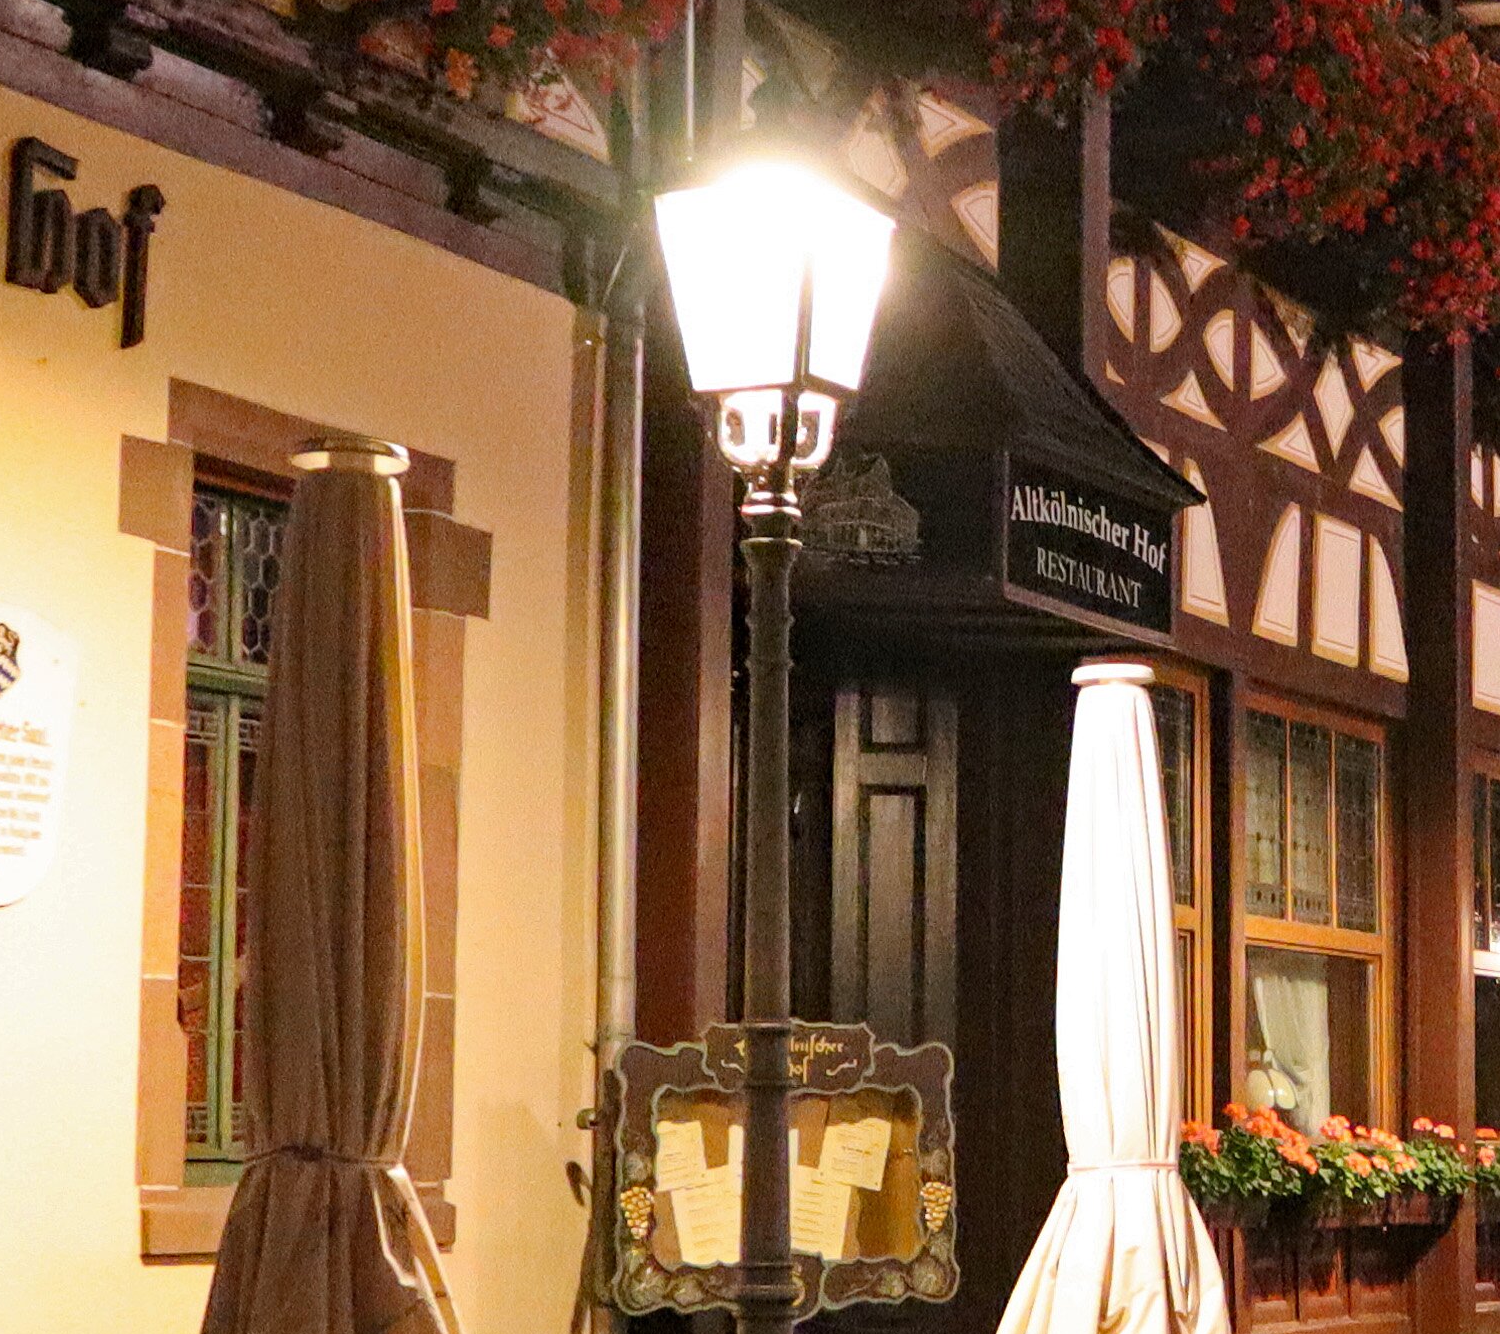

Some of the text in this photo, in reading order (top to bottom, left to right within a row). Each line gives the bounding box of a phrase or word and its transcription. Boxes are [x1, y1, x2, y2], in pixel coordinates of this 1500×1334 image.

[5, 136, 166, 349] Hof
[1010, 485, 1167, 575] Altkölnischer Hof
[1037, 546, 1142, 608] RESTAURANT
